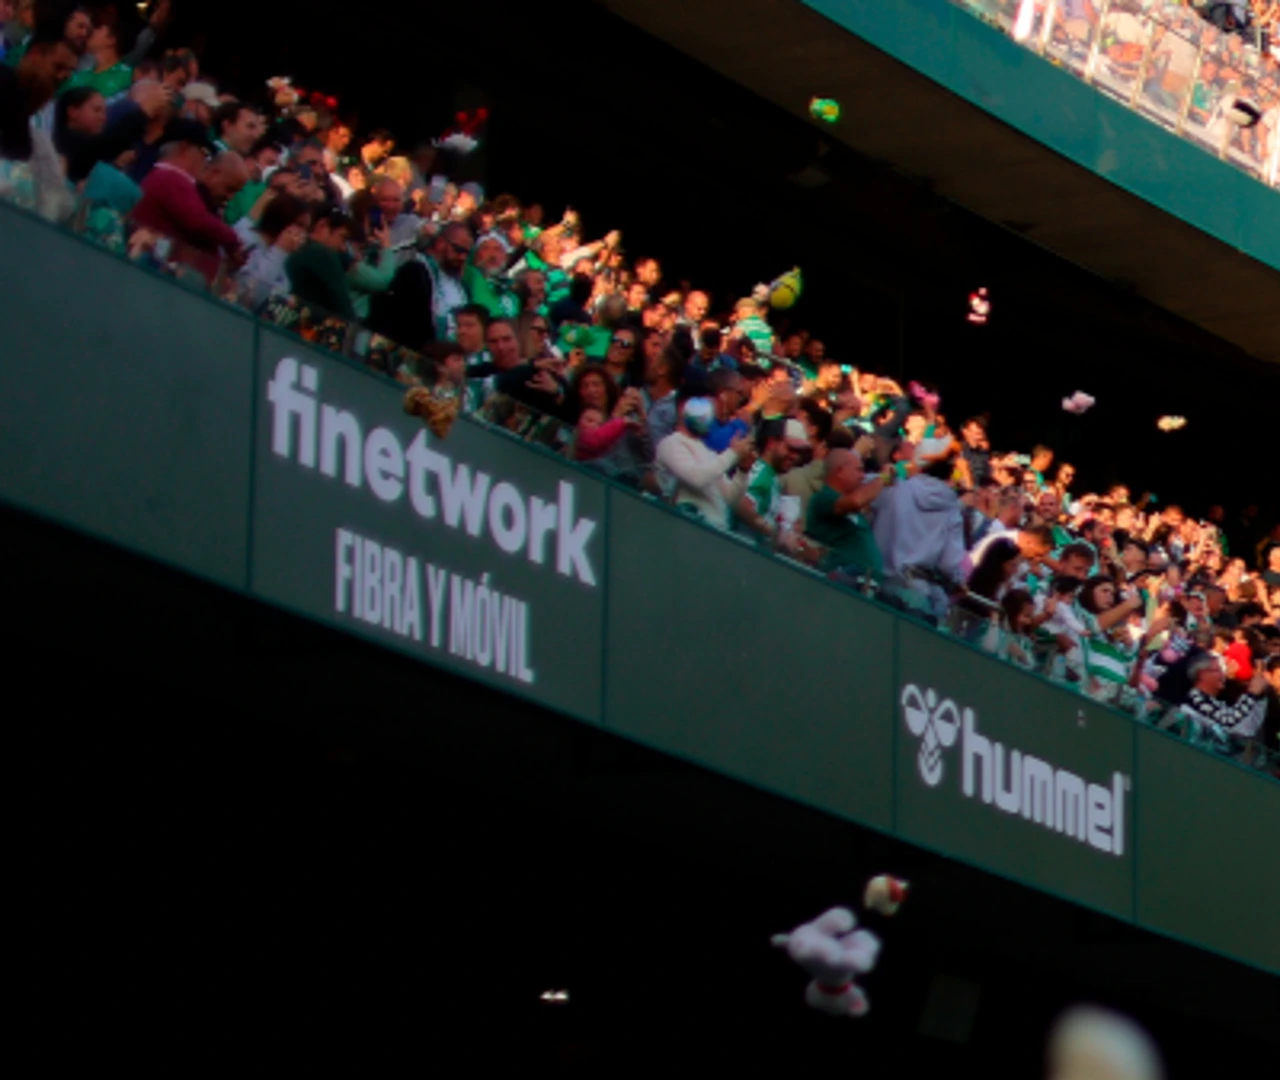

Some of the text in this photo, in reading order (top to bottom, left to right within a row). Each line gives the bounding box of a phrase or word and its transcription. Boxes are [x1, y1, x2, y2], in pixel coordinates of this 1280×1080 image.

[268, 356, 597, 587] finetwork
[335, 527, 535, 684] FIBRA Y MÓVIL
[963, 706, 1124, 856] hummel
